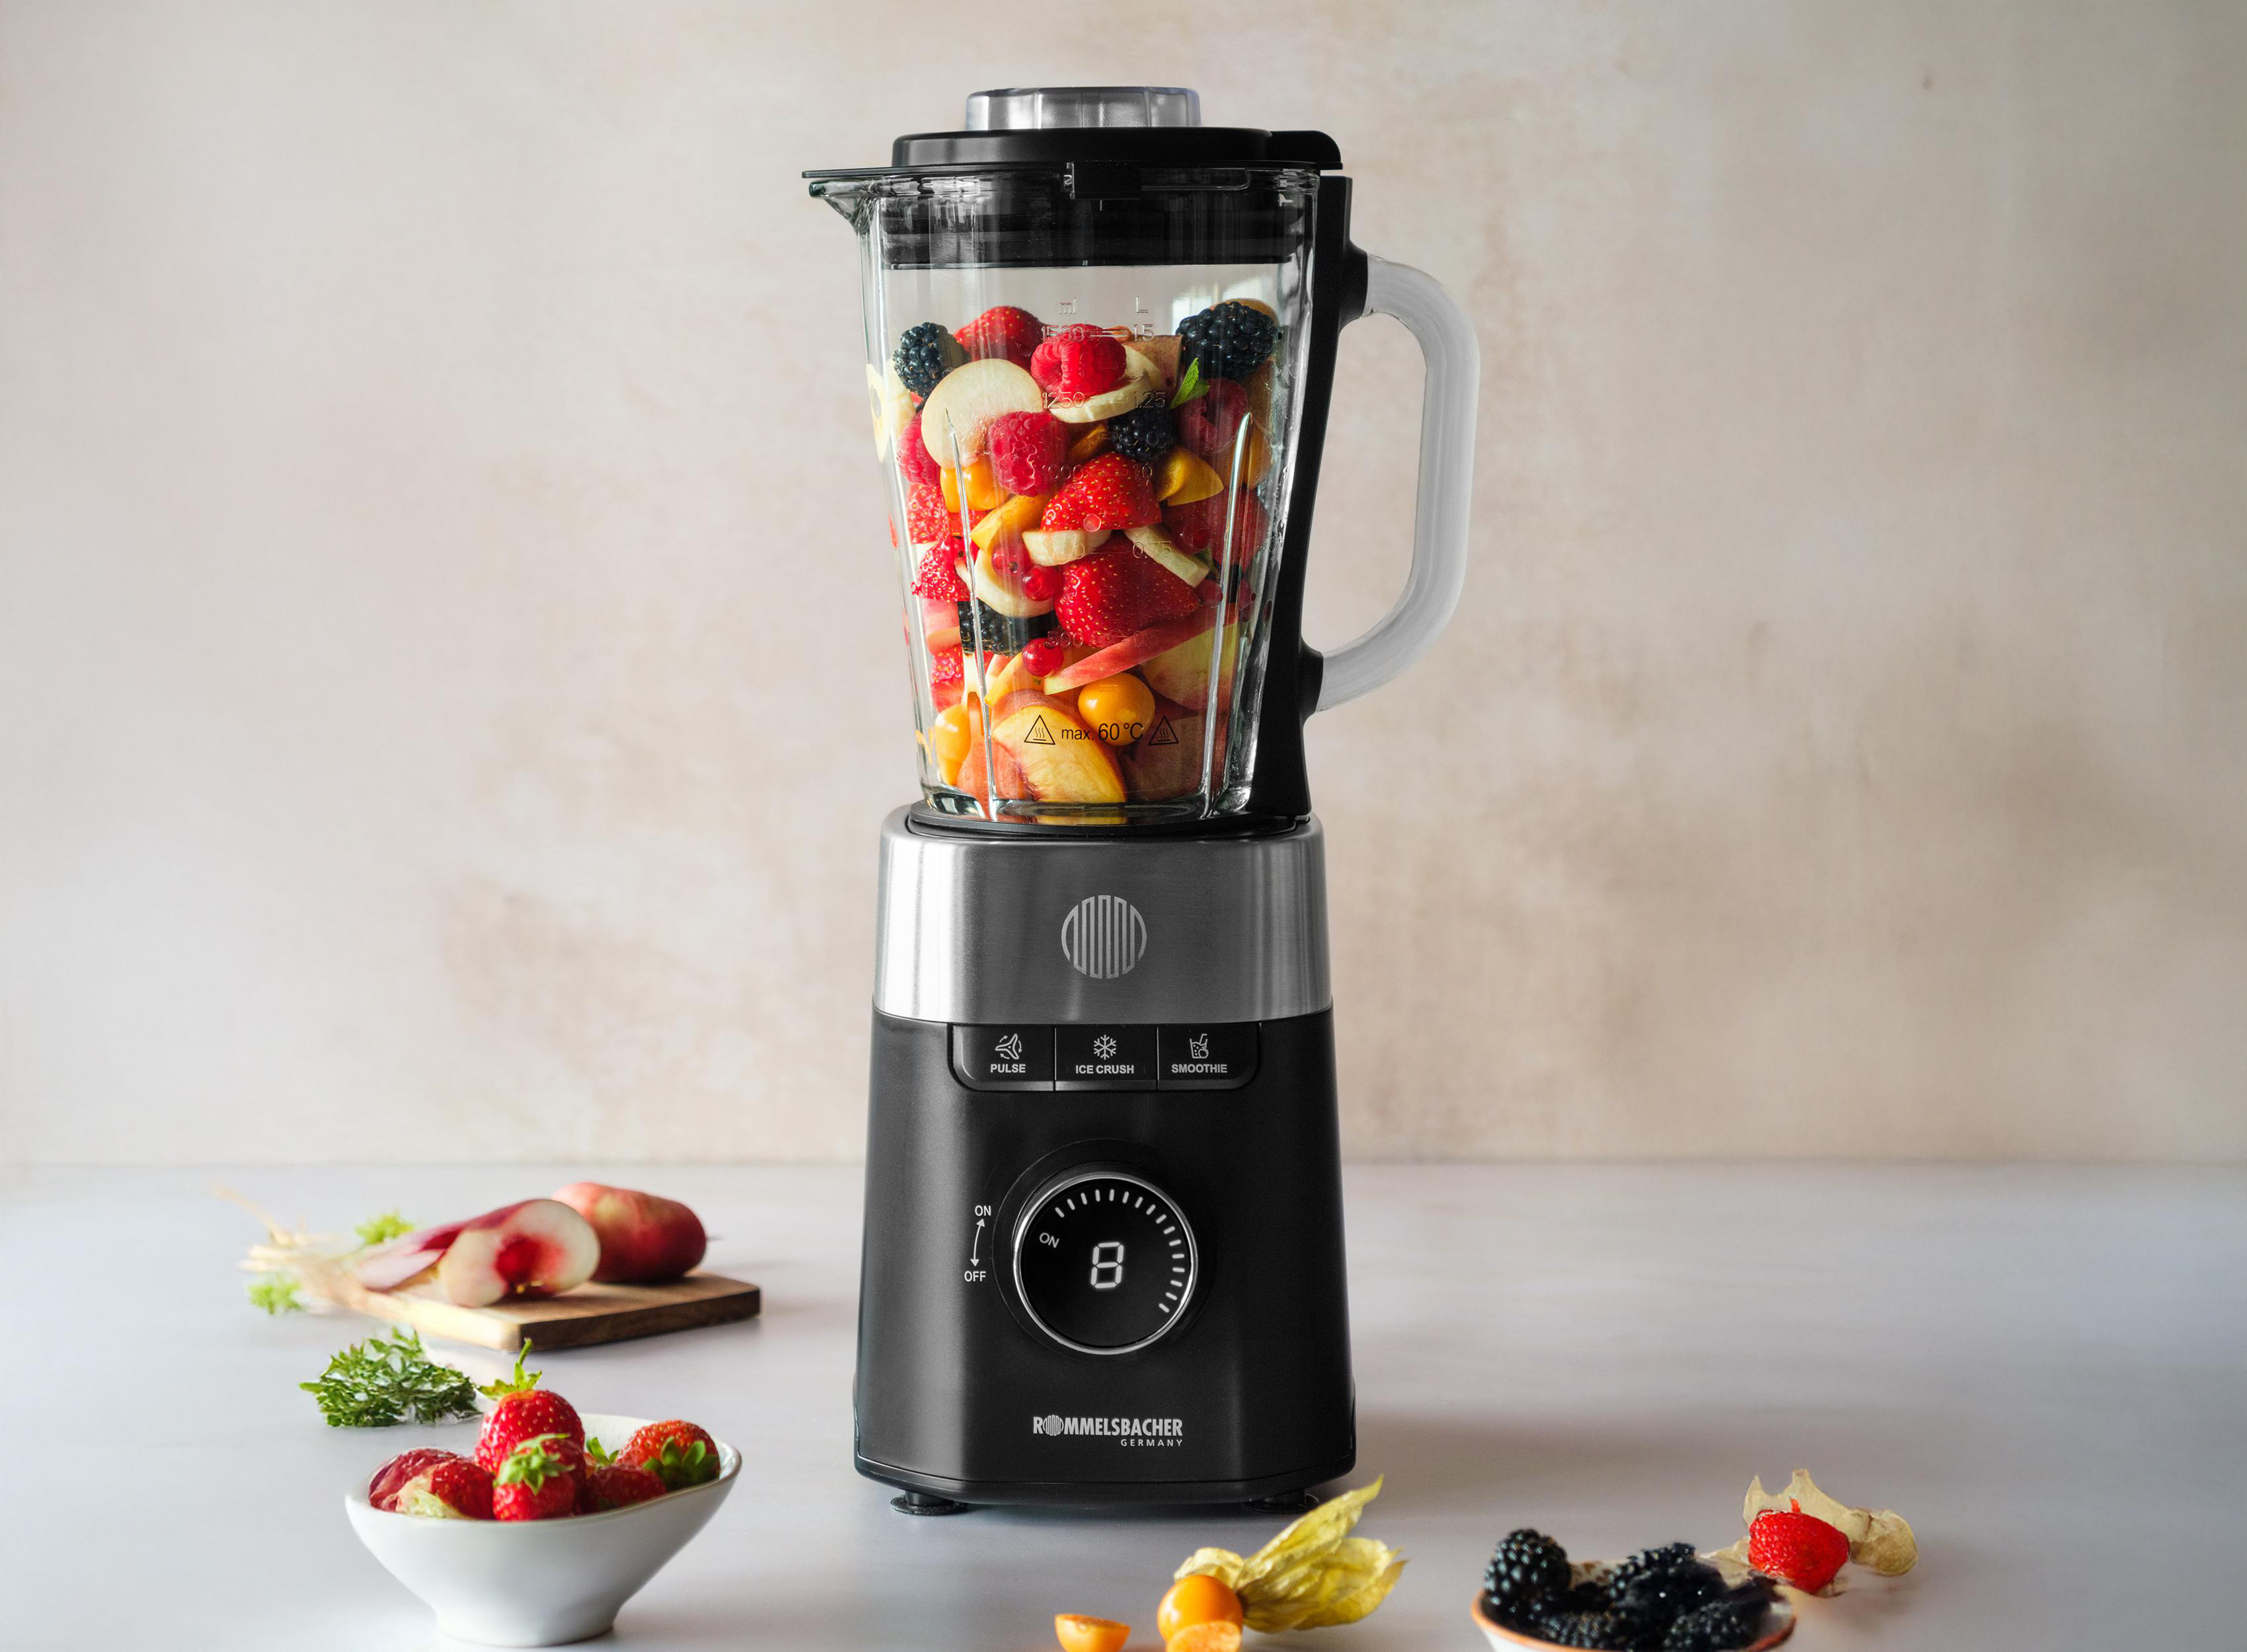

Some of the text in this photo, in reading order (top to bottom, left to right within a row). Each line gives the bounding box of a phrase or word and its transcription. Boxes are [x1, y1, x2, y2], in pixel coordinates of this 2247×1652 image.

[1059, 296, 1077, 314] ml
[1136, 296, 1149, 313] L
[1042, 324, 1085, 342] 1500
[1042, 391, 1085, 409] 1250
[1131, 391, 1166, 408] 1.25
[1061, 728, 1094, 740] max.
[1098, 723, 1120, 741] 60
[990, 1063, 1026, 1073] PULSE
[1075, 1065, 1135, 1074] ICE CRUSH
[1171, 1064, 1228, 1073] SMOOTHIE
[974, 1205, 991, 1217] ON
[1040, 1232, 1059, 1248] ON
[1090, 1242, 1124, 1289] 8
[964, 1270, 987, 1282] OFF
[1033, 1415, 1183, 1437] ROMMELSBACHER
[1120, 1439, 1183, 1447] GERMANY
